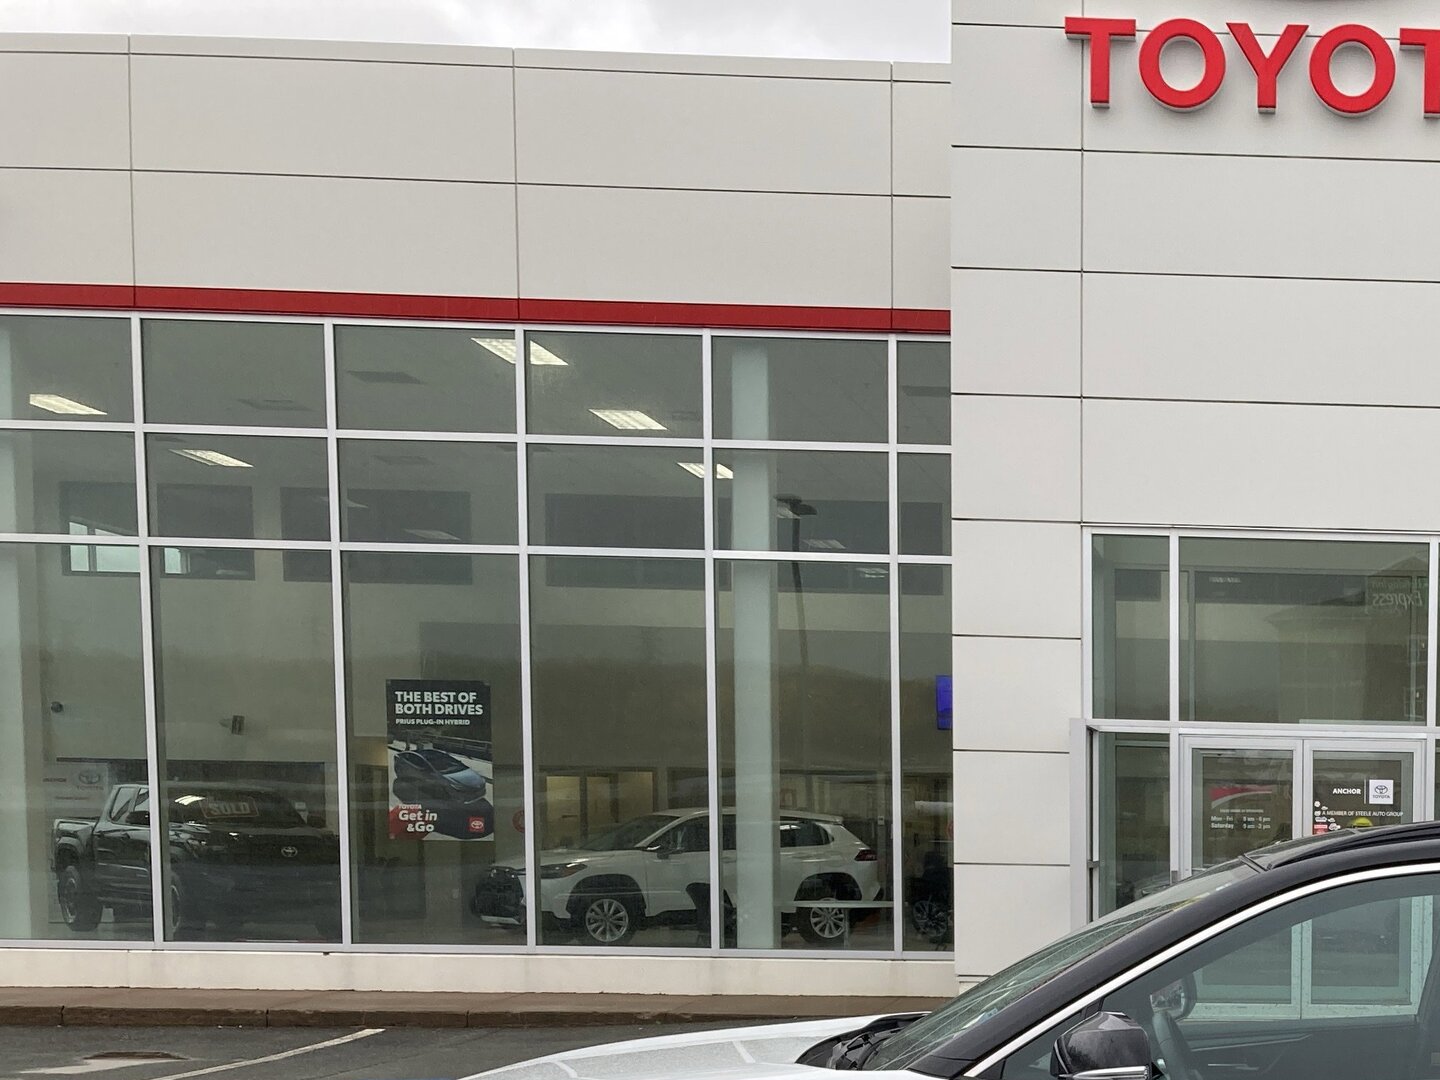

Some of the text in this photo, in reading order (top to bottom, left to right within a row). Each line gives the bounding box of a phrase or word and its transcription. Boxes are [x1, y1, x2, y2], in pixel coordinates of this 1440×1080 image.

[395, 691, 477, 703] THE BEST OF
[395, 703, 484, 715] BOTH DRIVES
[208, 801, 252, 815] SOLD
[398, 809, 438, 821] Get in
[406, 821, 435, 832] &Go
